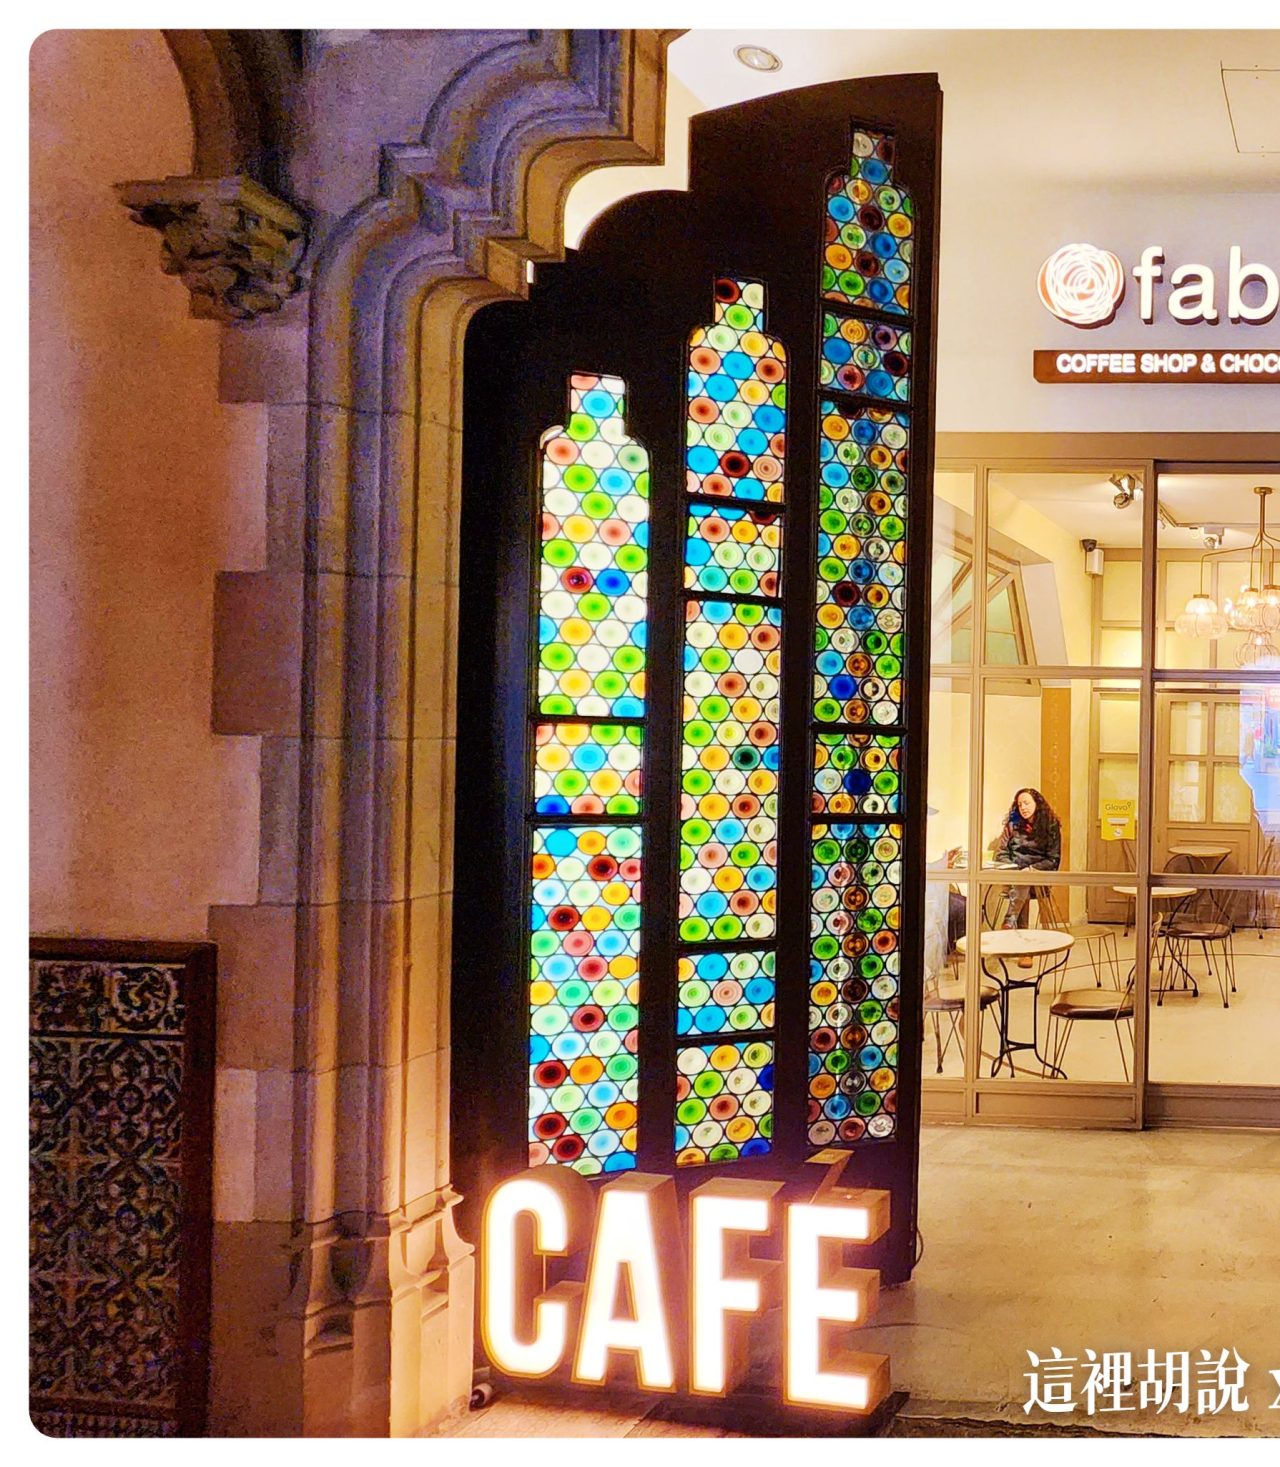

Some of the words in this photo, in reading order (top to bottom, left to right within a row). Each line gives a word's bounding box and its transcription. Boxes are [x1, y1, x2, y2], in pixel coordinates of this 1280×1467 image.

[1056, 353, 1136, 374] COFFEE
[1140, 353, 1198, 374] SHOP
[1200, 353, 1216, 374] &
